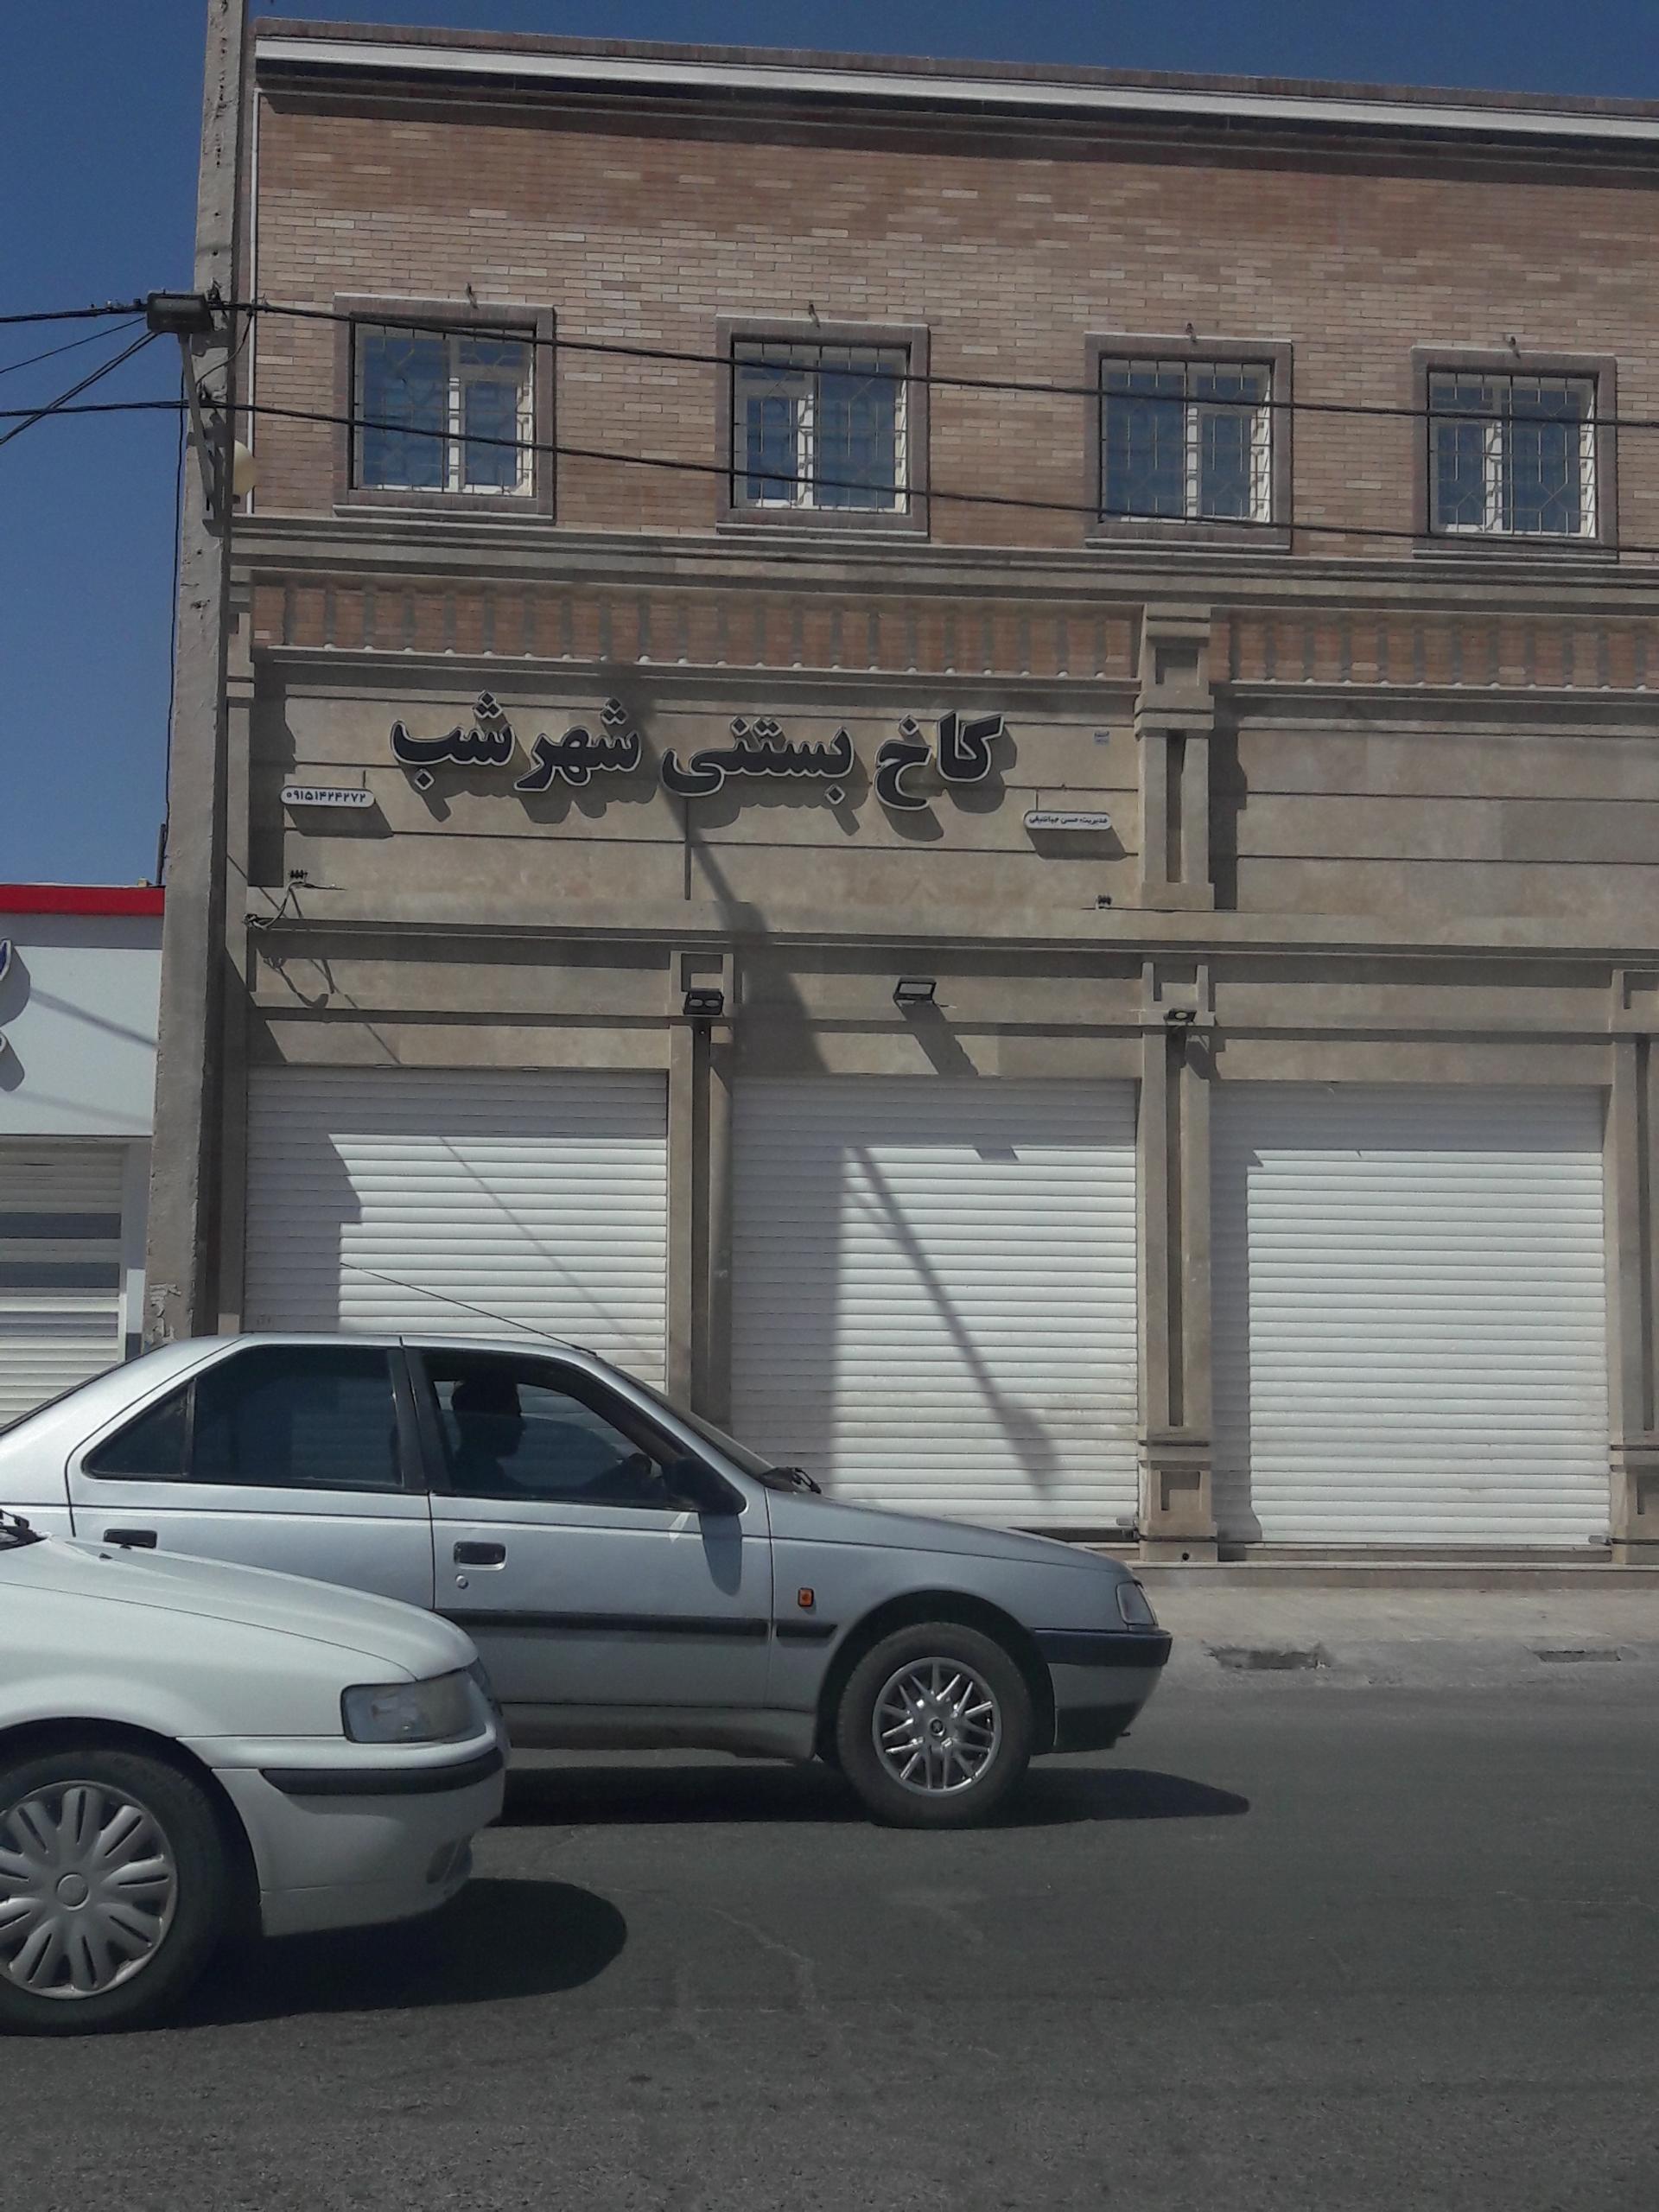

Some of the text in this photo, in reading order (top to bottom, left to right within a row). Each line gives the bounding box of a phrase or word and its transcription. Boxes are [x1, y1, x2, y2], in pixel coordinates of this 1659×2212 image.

[390, 690, 1005, 810] کاخ بستنی شهر شب
